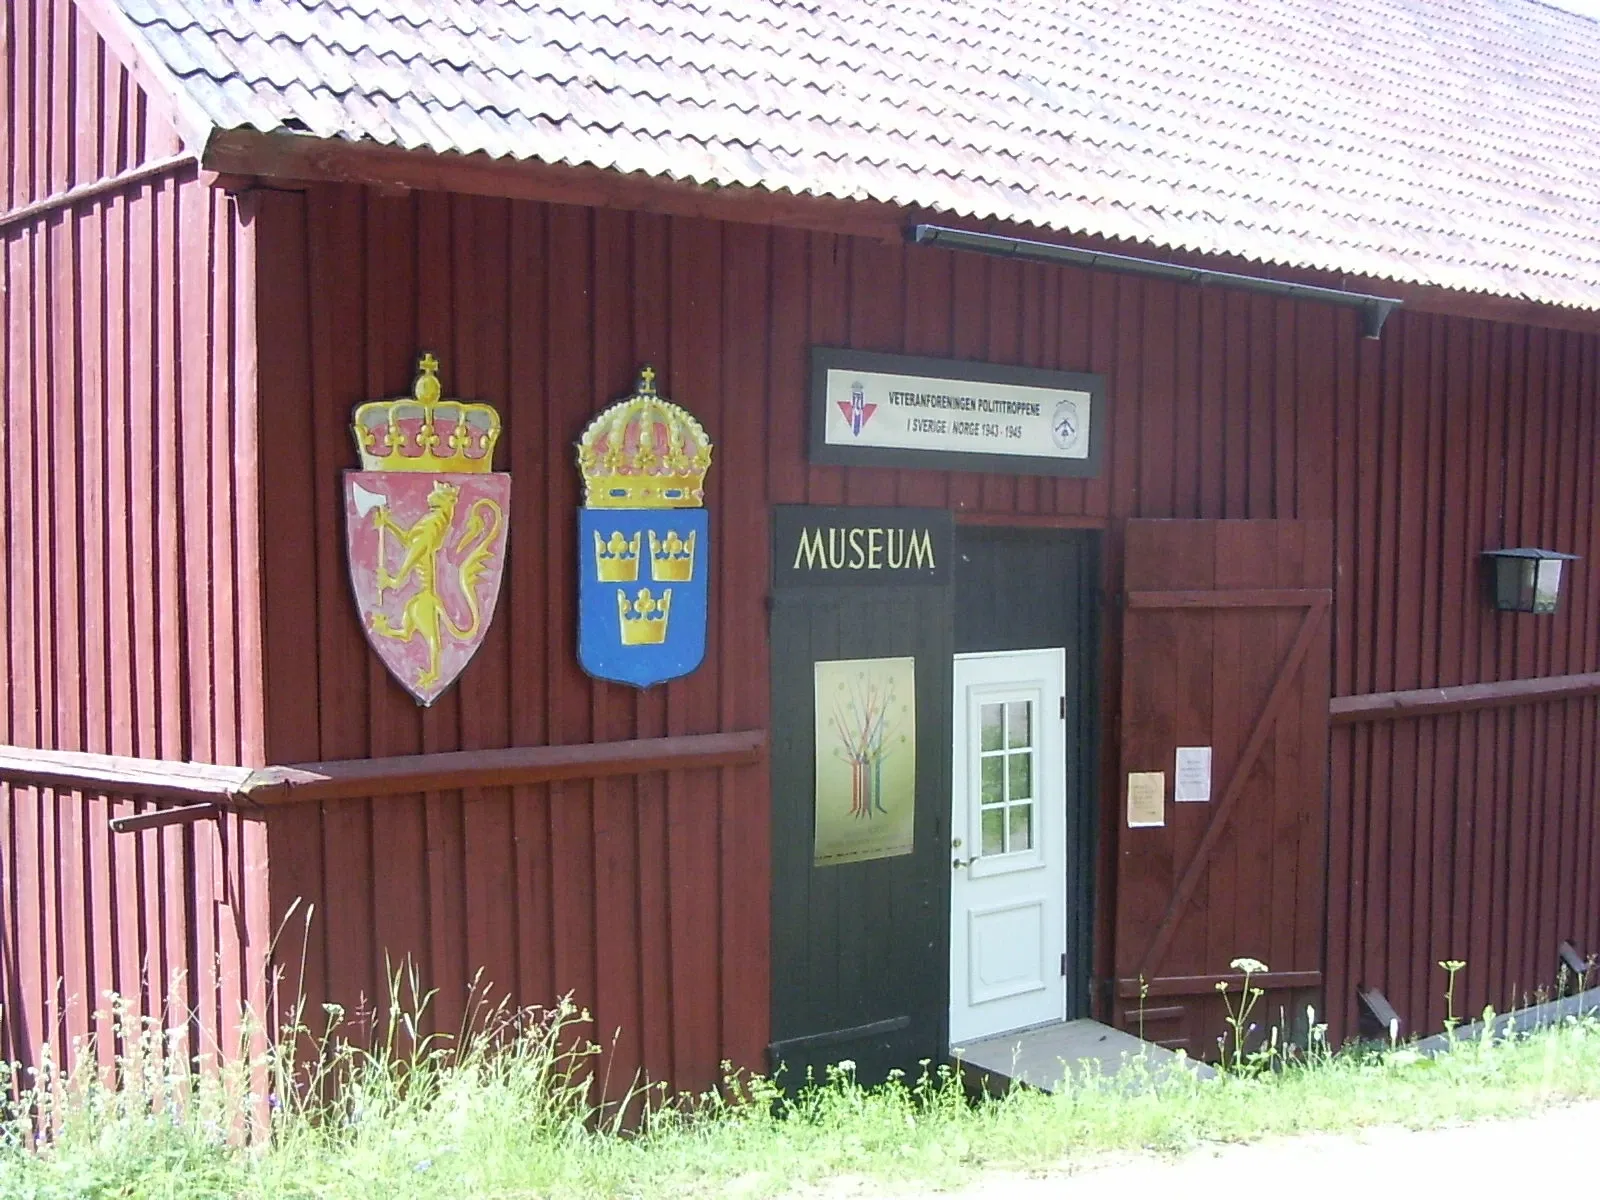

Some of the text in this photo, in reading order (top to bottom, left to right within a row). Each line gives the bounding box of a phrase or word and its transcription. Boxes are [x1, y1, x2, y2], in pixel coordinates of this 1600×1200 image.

[889, 391, 1040, 417] VETERANFORENINGEN POLITITROPPENE
[912, 418, 947, 434] SVERIGE
[952, 420, 979, 436] NORGE
[982, 423, 999, 438] 1943
[1005, 425, 1022, 439] 1945
[793, 526, 936, 571] MUSEUM
